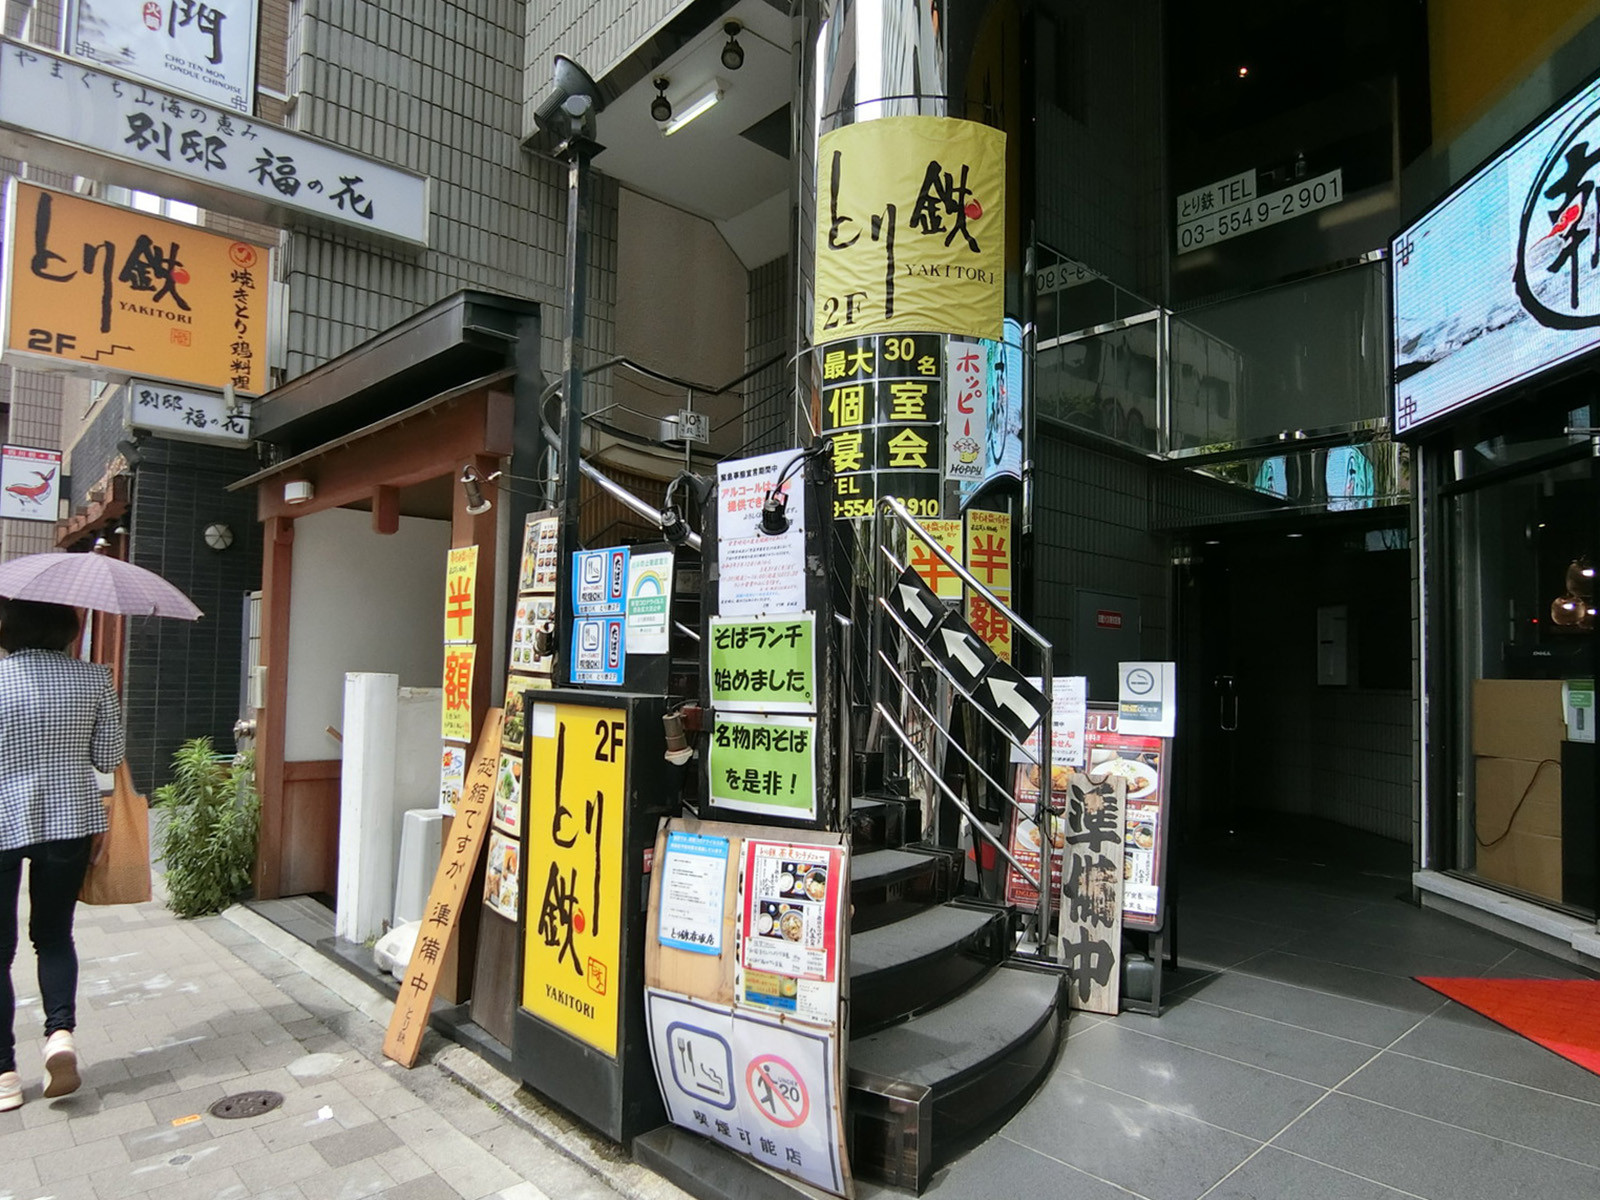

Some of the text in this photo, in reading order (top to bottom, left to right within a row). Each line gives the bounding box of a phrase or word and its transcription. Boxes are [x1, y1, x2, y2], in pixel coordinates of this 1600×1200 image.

[164, 62, 242, 95] FONDUE CHINOISE
[165, 53, 226, 80] CHO TEN MON
[248, 147, 374, 221] 福の花
[1181, 178, 1252, 218] とり鉄 TEL
[1181, 177, 1339, 248] 03-5549-2901
[827, 149, 983, 320] とり鉄
[30, 192, 192, 333] とり鉄
[904, 263, 996, 286] YAKITORI
[119, 300, 193, 325] YAKITORI
[822, 292, 869, 331] 2F
[27, 328, 77, 354] 2F
[834, 477, 861, 495] EL
[714, 624, 803, 650] そばランチ
[714, 668, 811, 699] 始めました。
[594, 719, 625, 764] 2F
[715, 723, 809, 753] 名物肉そば
[538, 722, 604, 977] とり鉄
[1063, 782, 1122, 1004] 準備中
[545, 984, 596, 1021] YAKITORI
[779, 1083, 800, 1103] 20
[692, 1109, 803, 1166] 喫煙可能店
